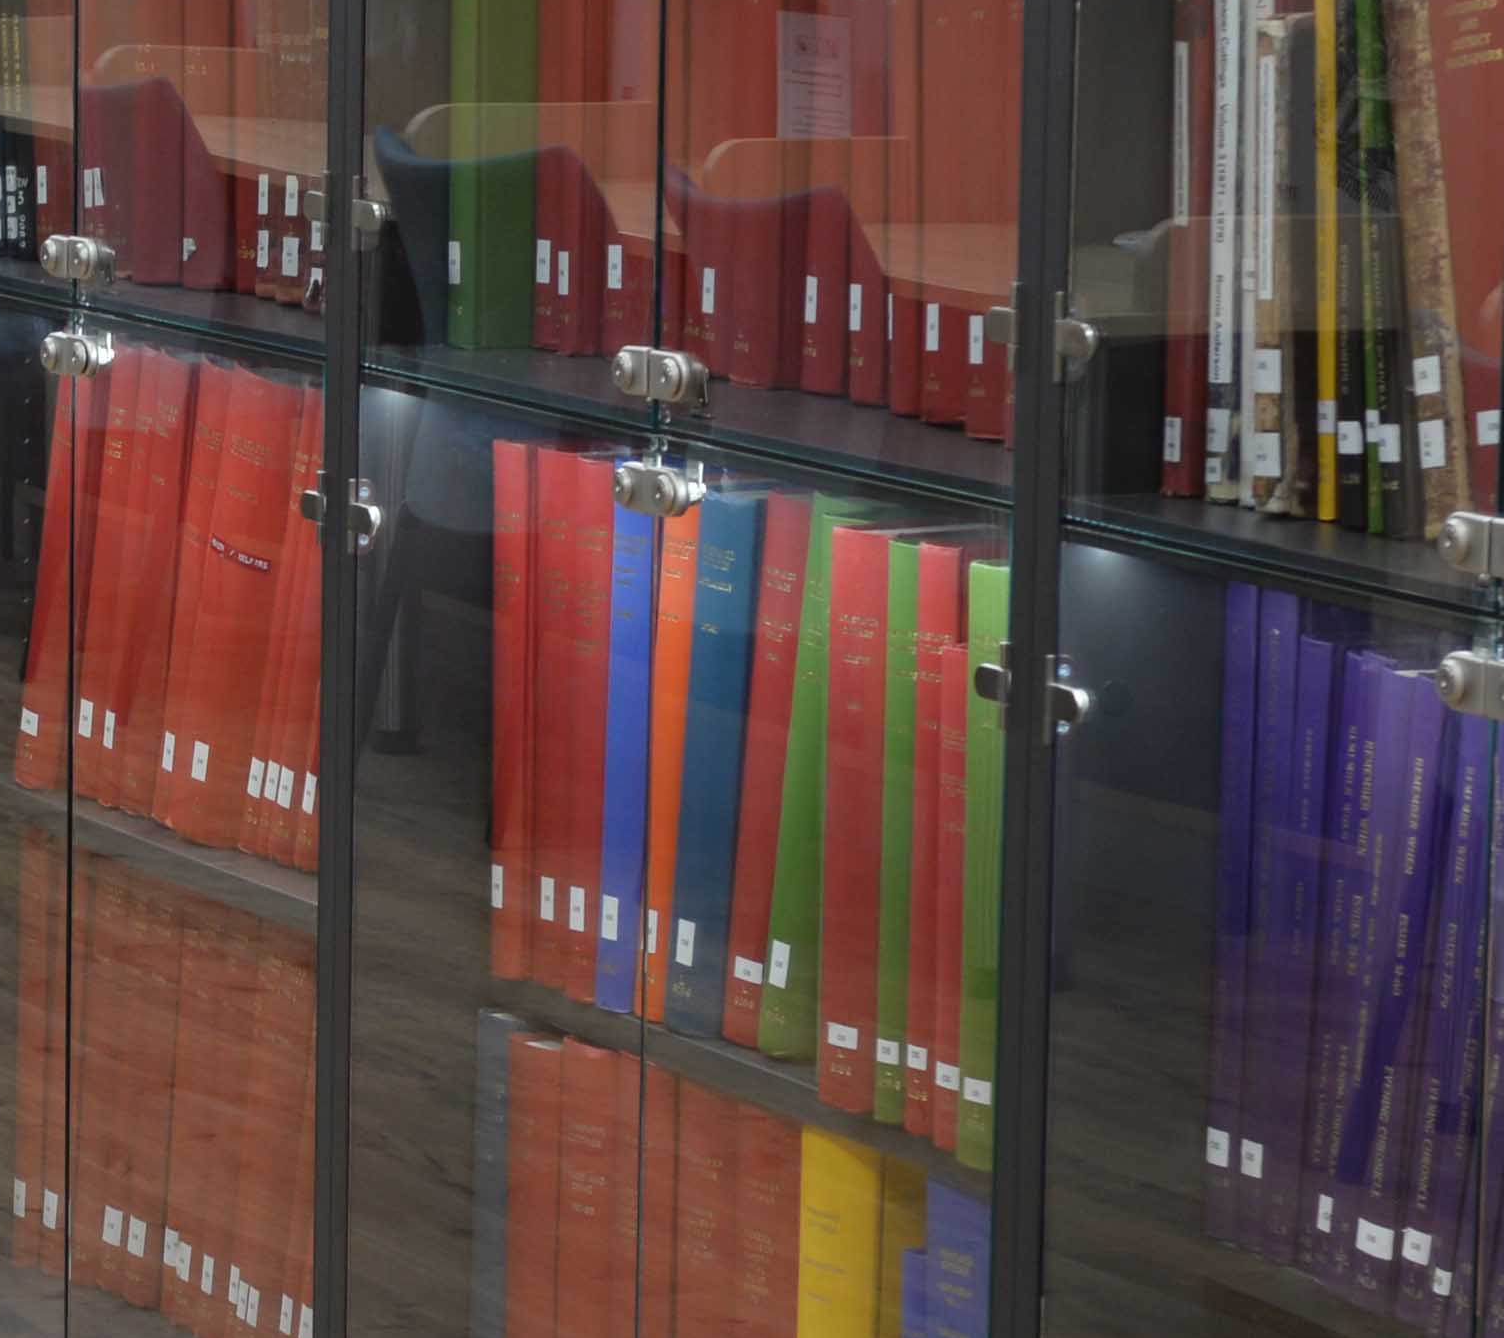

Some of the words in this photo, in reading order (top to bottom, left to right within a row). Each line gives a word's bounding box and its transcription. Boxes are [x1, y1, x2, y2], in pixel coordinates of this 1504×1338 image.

[1408, 757, 1424, 829] REMEMBER
[1404, 834, 1418, 876] WHEN
[1370, 1125, 1389, 1198] CHRONICLE
